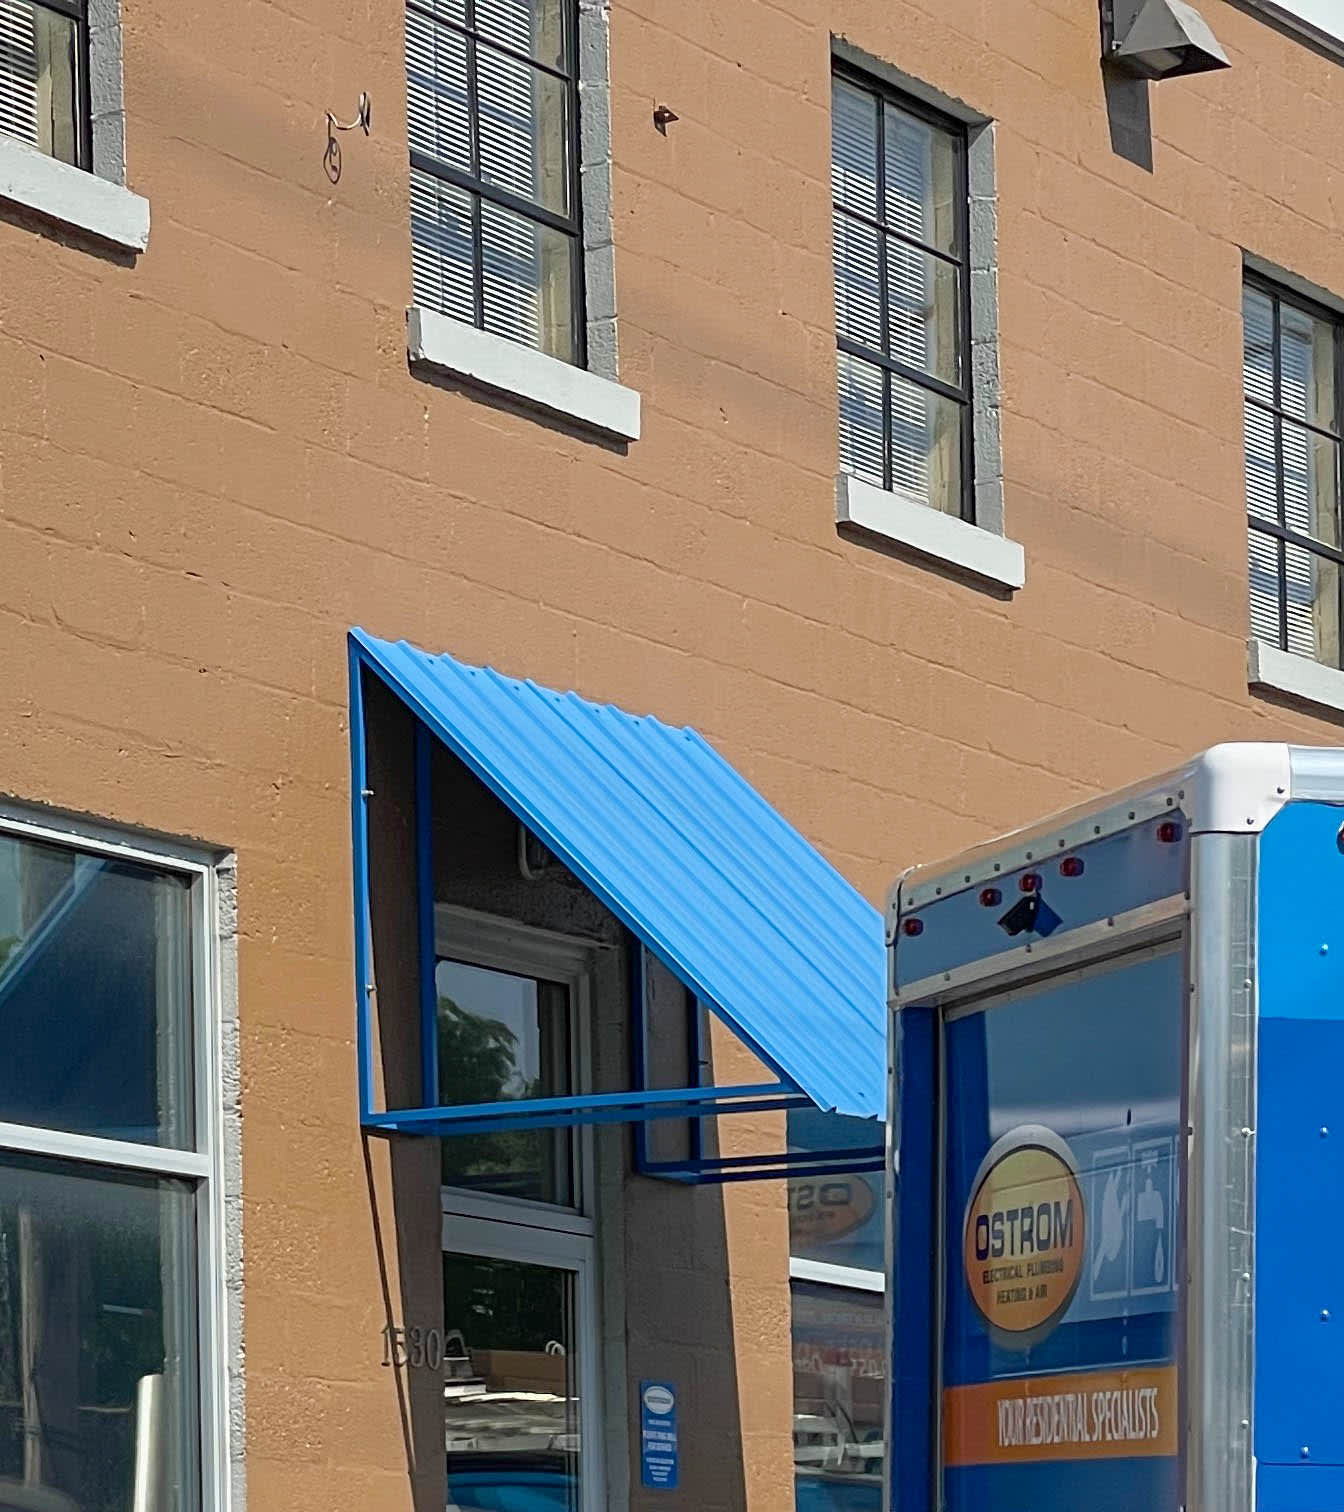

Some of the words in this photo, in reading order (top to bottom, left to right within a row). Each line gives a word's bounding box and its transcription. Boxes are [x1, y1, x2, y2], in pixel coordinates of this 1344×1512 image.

[975, 1199, 1073, 1261] OSTROM
[997, 1398, 1025, 1447] YOUR
[1025, 1391, 1091, 1445] RESIDENTIAL
[1092, 1387, 1159, 1441] SPECIALISTS
